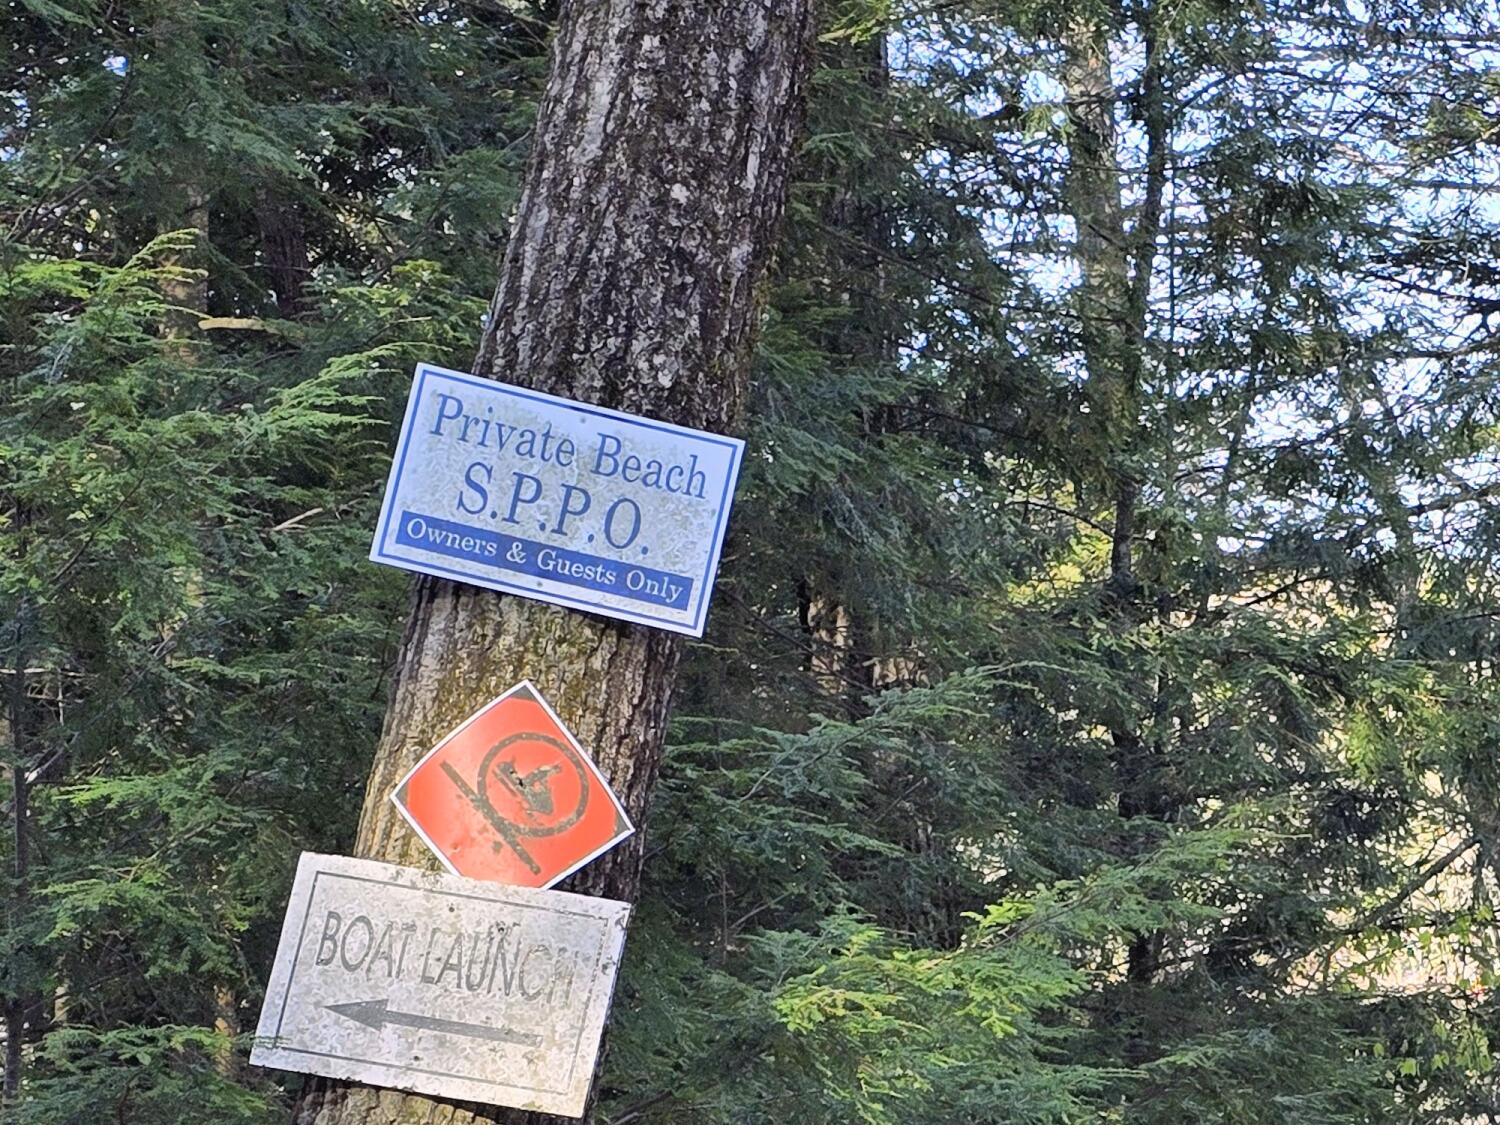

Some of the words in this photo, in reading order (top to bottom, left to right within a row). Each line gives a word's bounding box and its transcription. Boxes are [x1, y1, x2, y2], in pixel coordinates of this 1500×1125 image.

[429, 392, 576, 467] Private
[590, 432, 708, 499] Beach
[456, 461, 649, 556] S.P.P.O.
[406, 518, 498, 557] Owners
[506, 541, 527, 564] &
[536, 550, 617, 585] Guests
[626, 570, 683, 603] Only
[315, 909, 418, 981] BOAT
